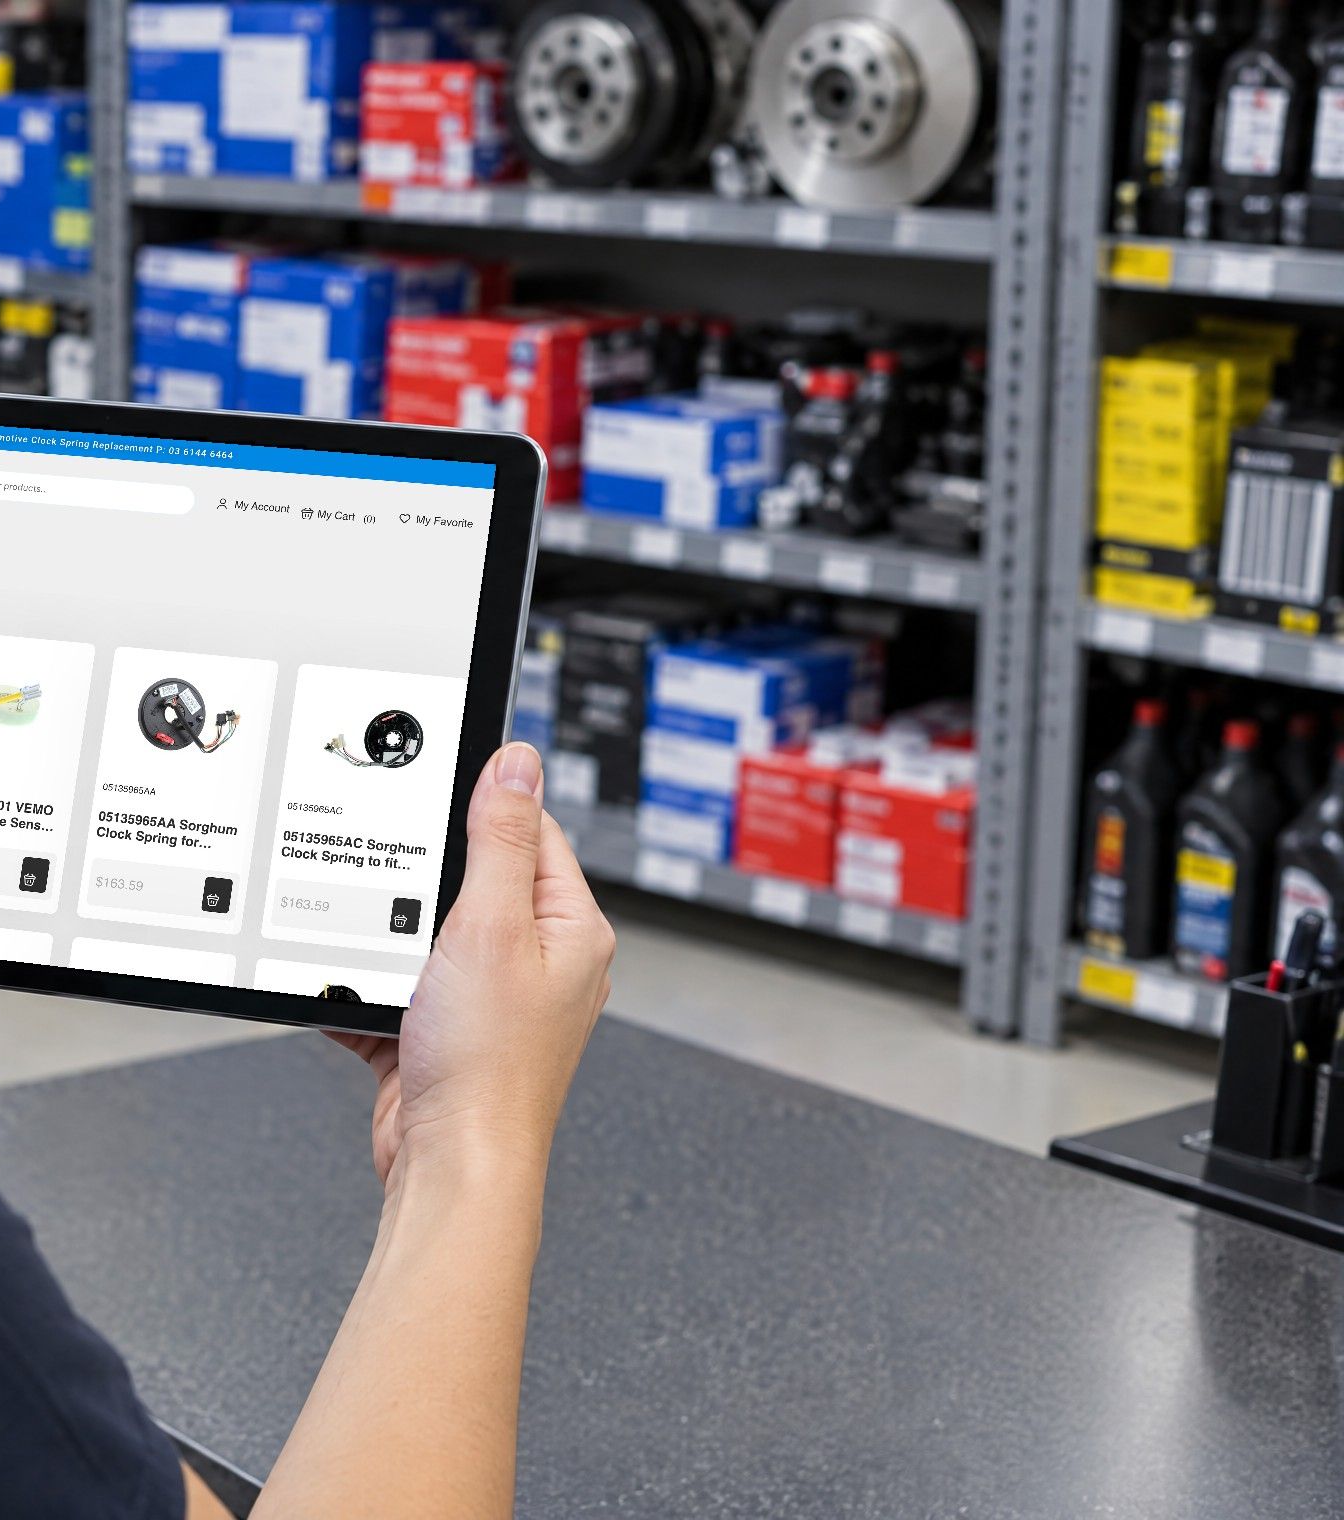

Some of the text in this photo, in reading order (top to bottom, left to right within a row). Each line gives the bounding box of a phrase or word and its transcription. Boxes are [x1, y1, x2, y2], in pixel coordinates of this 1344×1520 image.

[31, 436, 57, 446] Clock
[59, 438, 90, 449] Spring
[92, 440, 153, 453] Replacement
[156, 445, 165, 454] P:
[168, 447, 180, 455] 03
[183, 448, 207, 457] 6144
[209, 450, 233, 459] 6464
[234, 500, 291, 514] My Account
[317, 509, 333, 522] My
[334, 511, 356, 522] Cart
[415, 515, 474, 529] My Favorite
[102, 782, 156, 796] 05135965AA
[15, 801, 54, 816] VEMO
[287, 802, 343, 815] 05135965AC
[10, 817, 53, 832] Sens...
[98, 810, 238, 836] 05135965AA Sorghum
[96, 826, 212, 849] Clock Spring for...
[283, 830, 427, 856] 05135965AC Sorghum
[281, 846, 411, 870] Clock Spring to fit...
[95, 876, 144, 892] $163.59
[280, 896, 330, 912] $163.59
